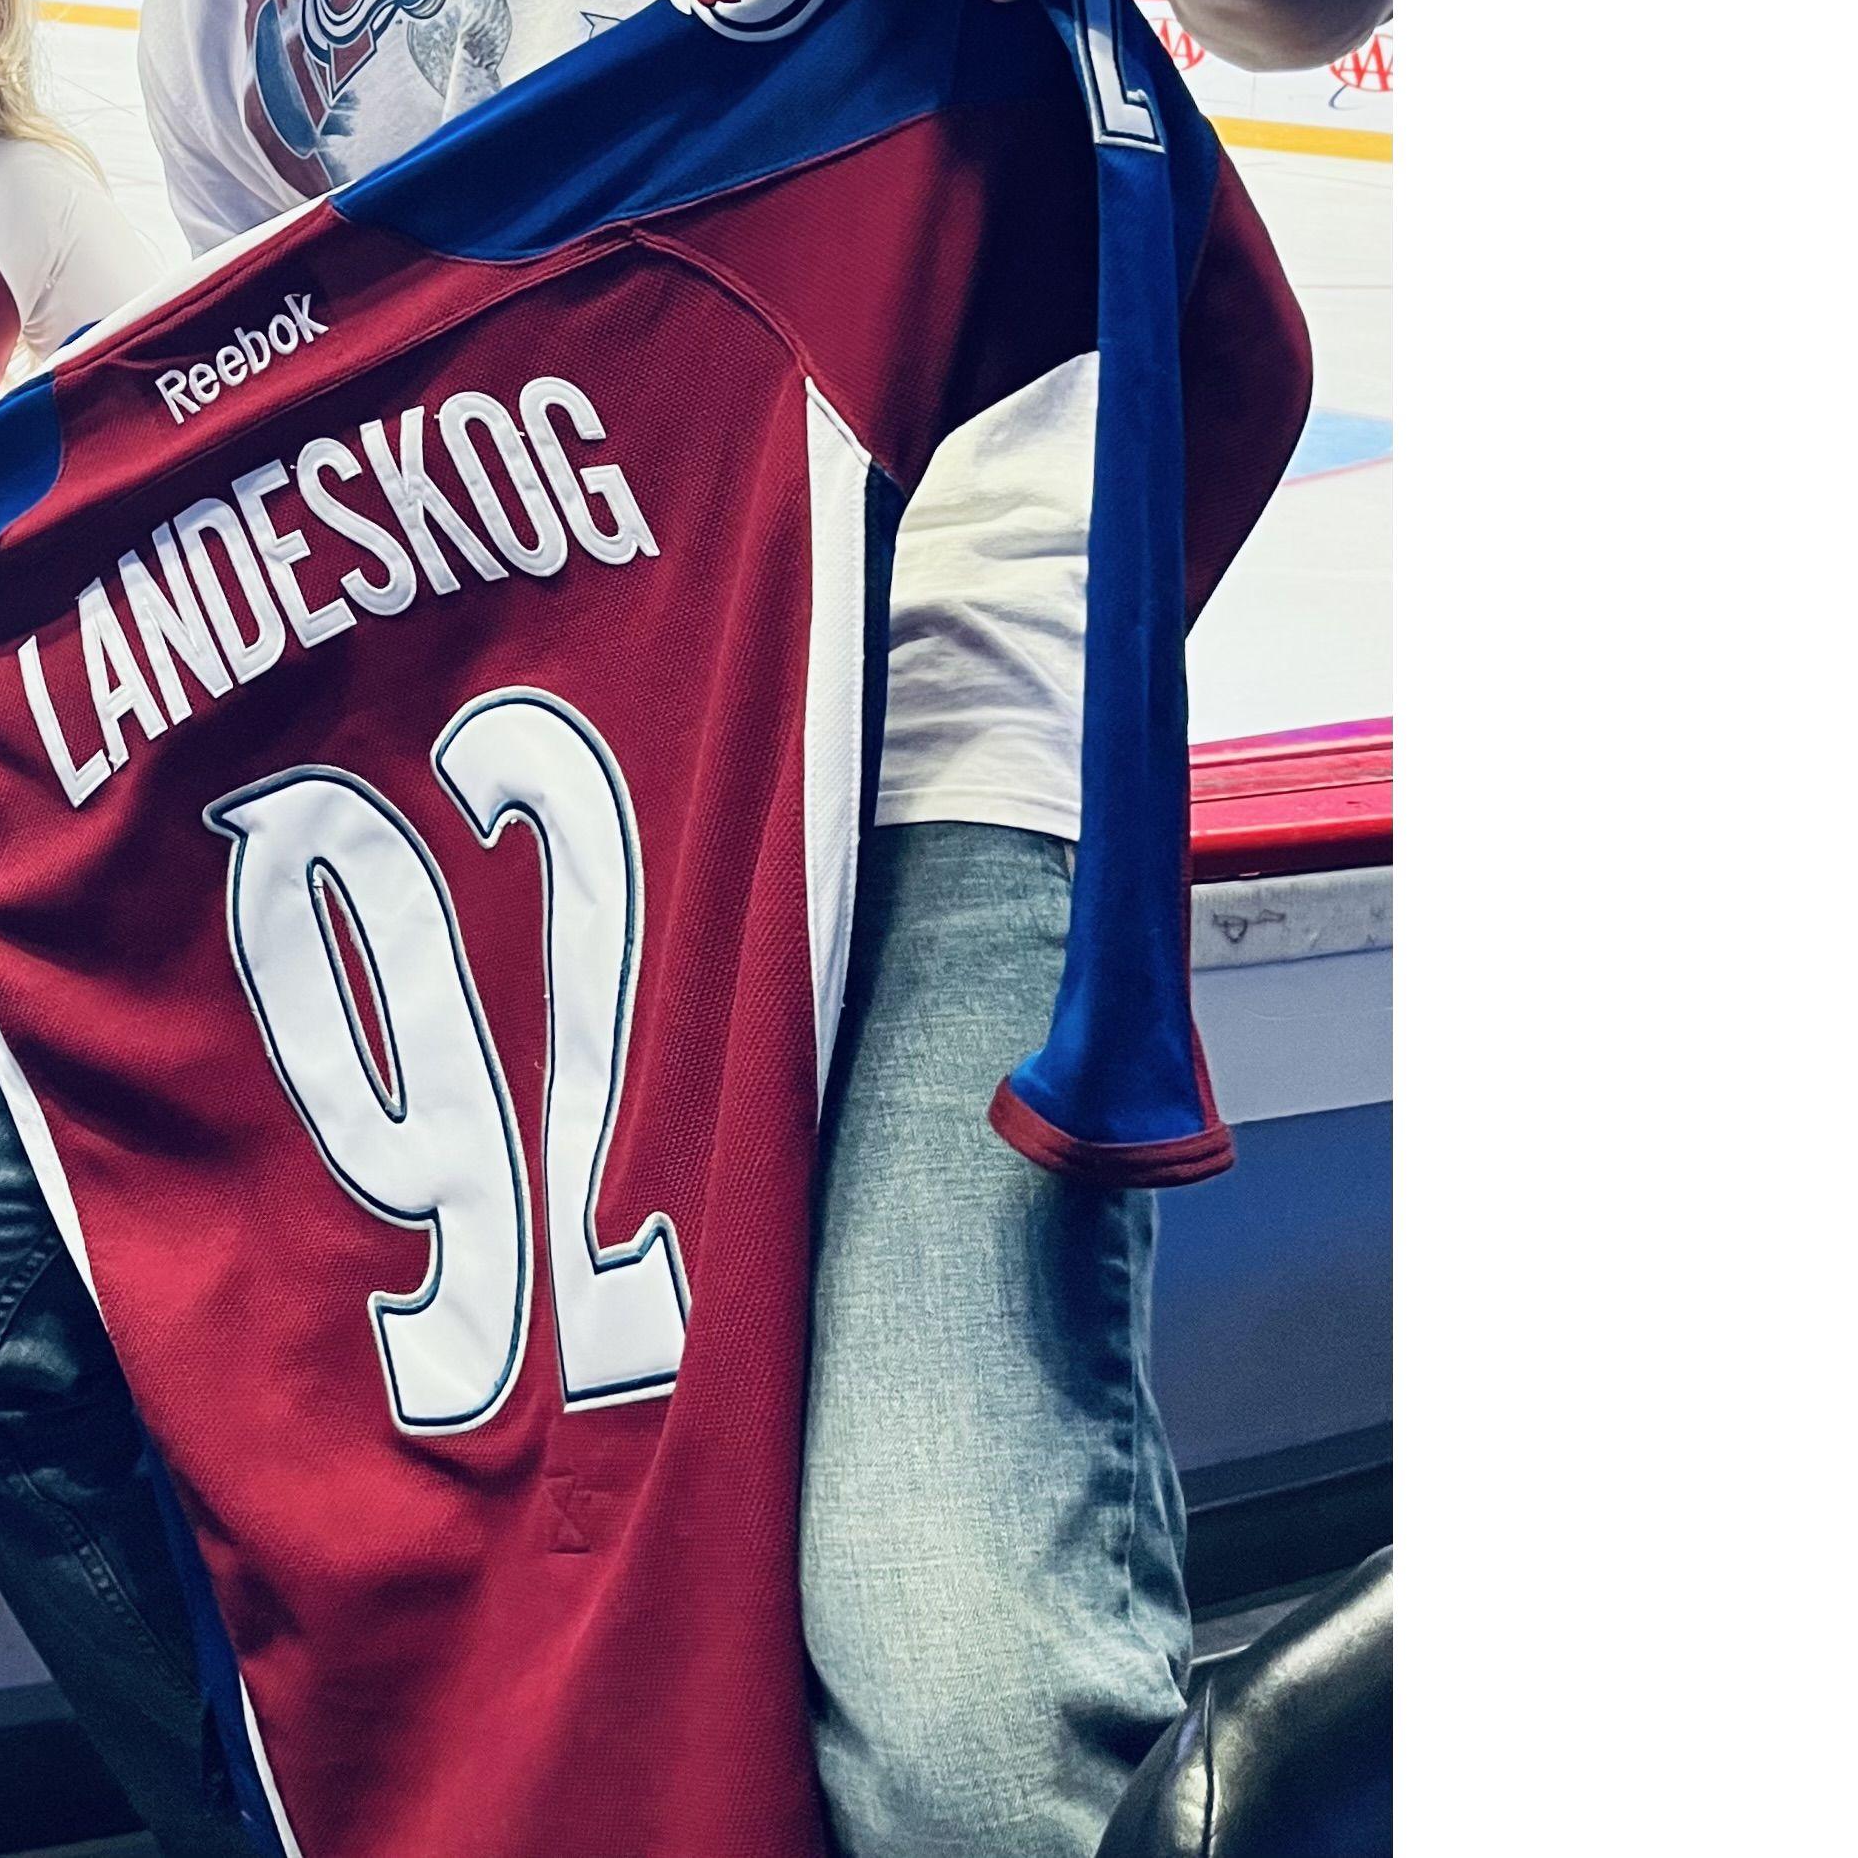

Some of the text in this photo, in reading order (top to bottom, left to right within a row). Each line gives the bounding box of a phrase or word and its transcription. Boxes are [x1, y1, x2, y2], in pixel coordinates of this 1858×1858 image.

[155, 292, 330, 425] Reebok
[17, 376, 660, 809] LANDESKOG
[201, 685, 692, 1436] 92
